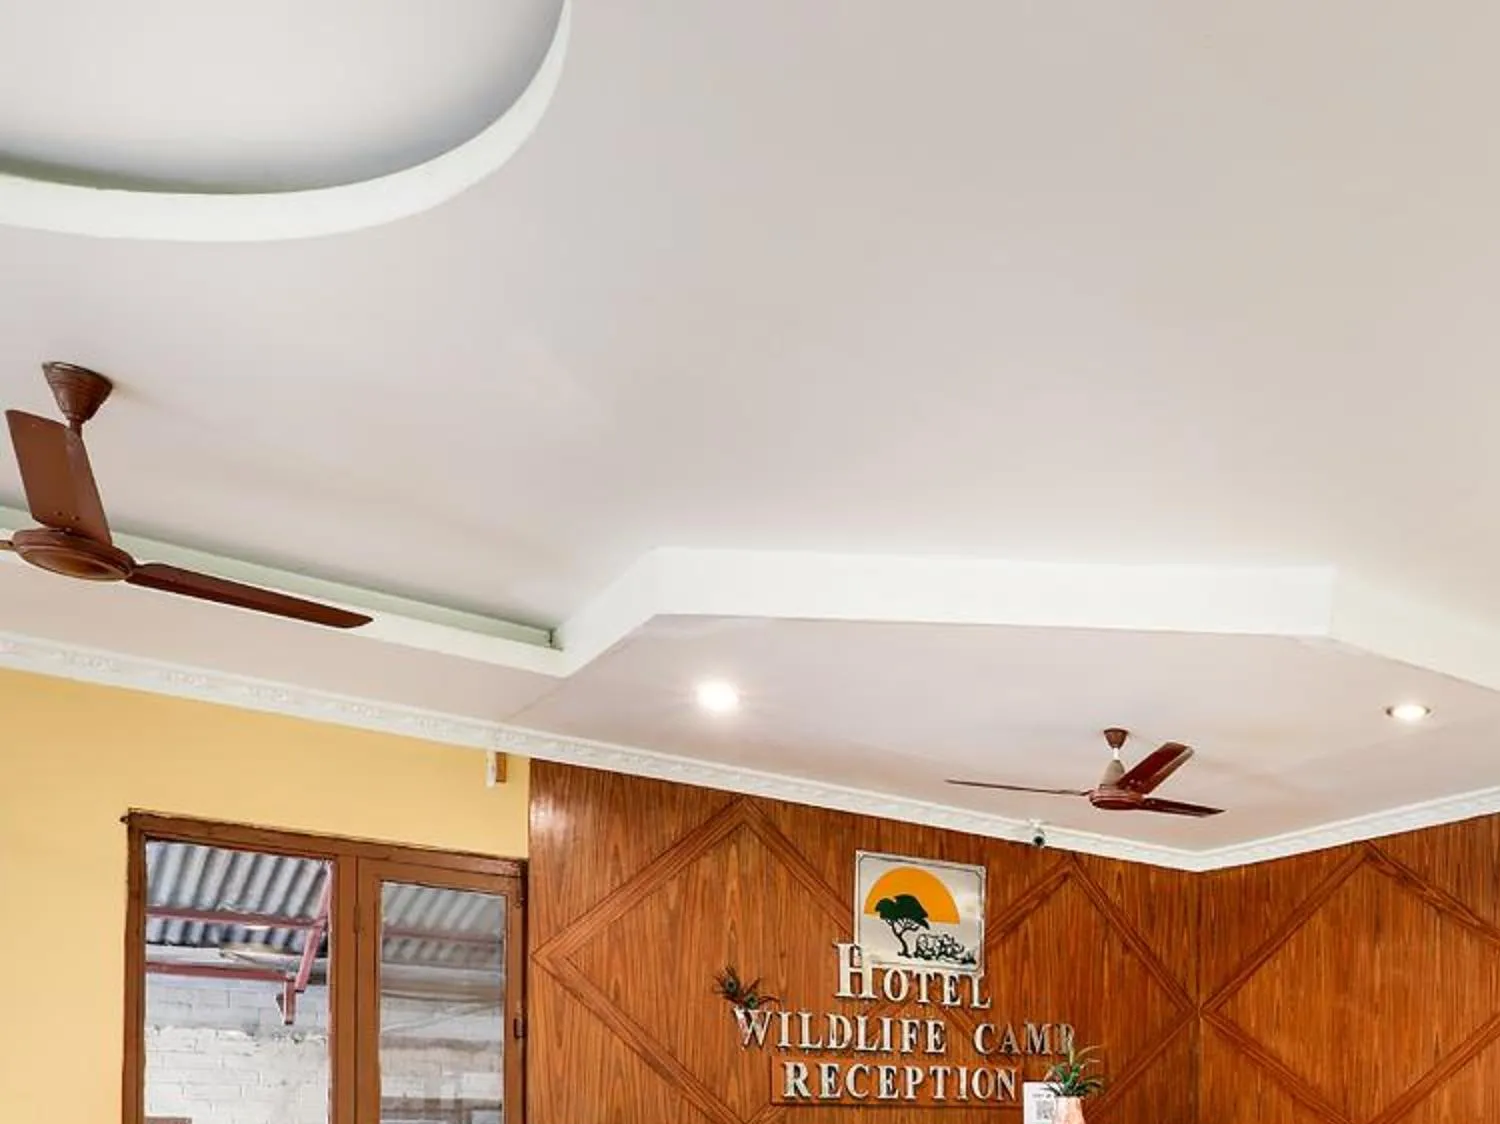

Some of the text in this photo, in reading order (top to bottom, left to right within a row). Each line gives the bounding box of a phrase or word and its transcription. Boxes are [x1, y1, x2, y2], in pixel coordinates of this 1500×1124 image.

[833, 941, 992, 1009] HOTEL
[734, 1005, 948, 1054] WILDLIFE
[783, 1059, 1018, 1102] RECEPTION
